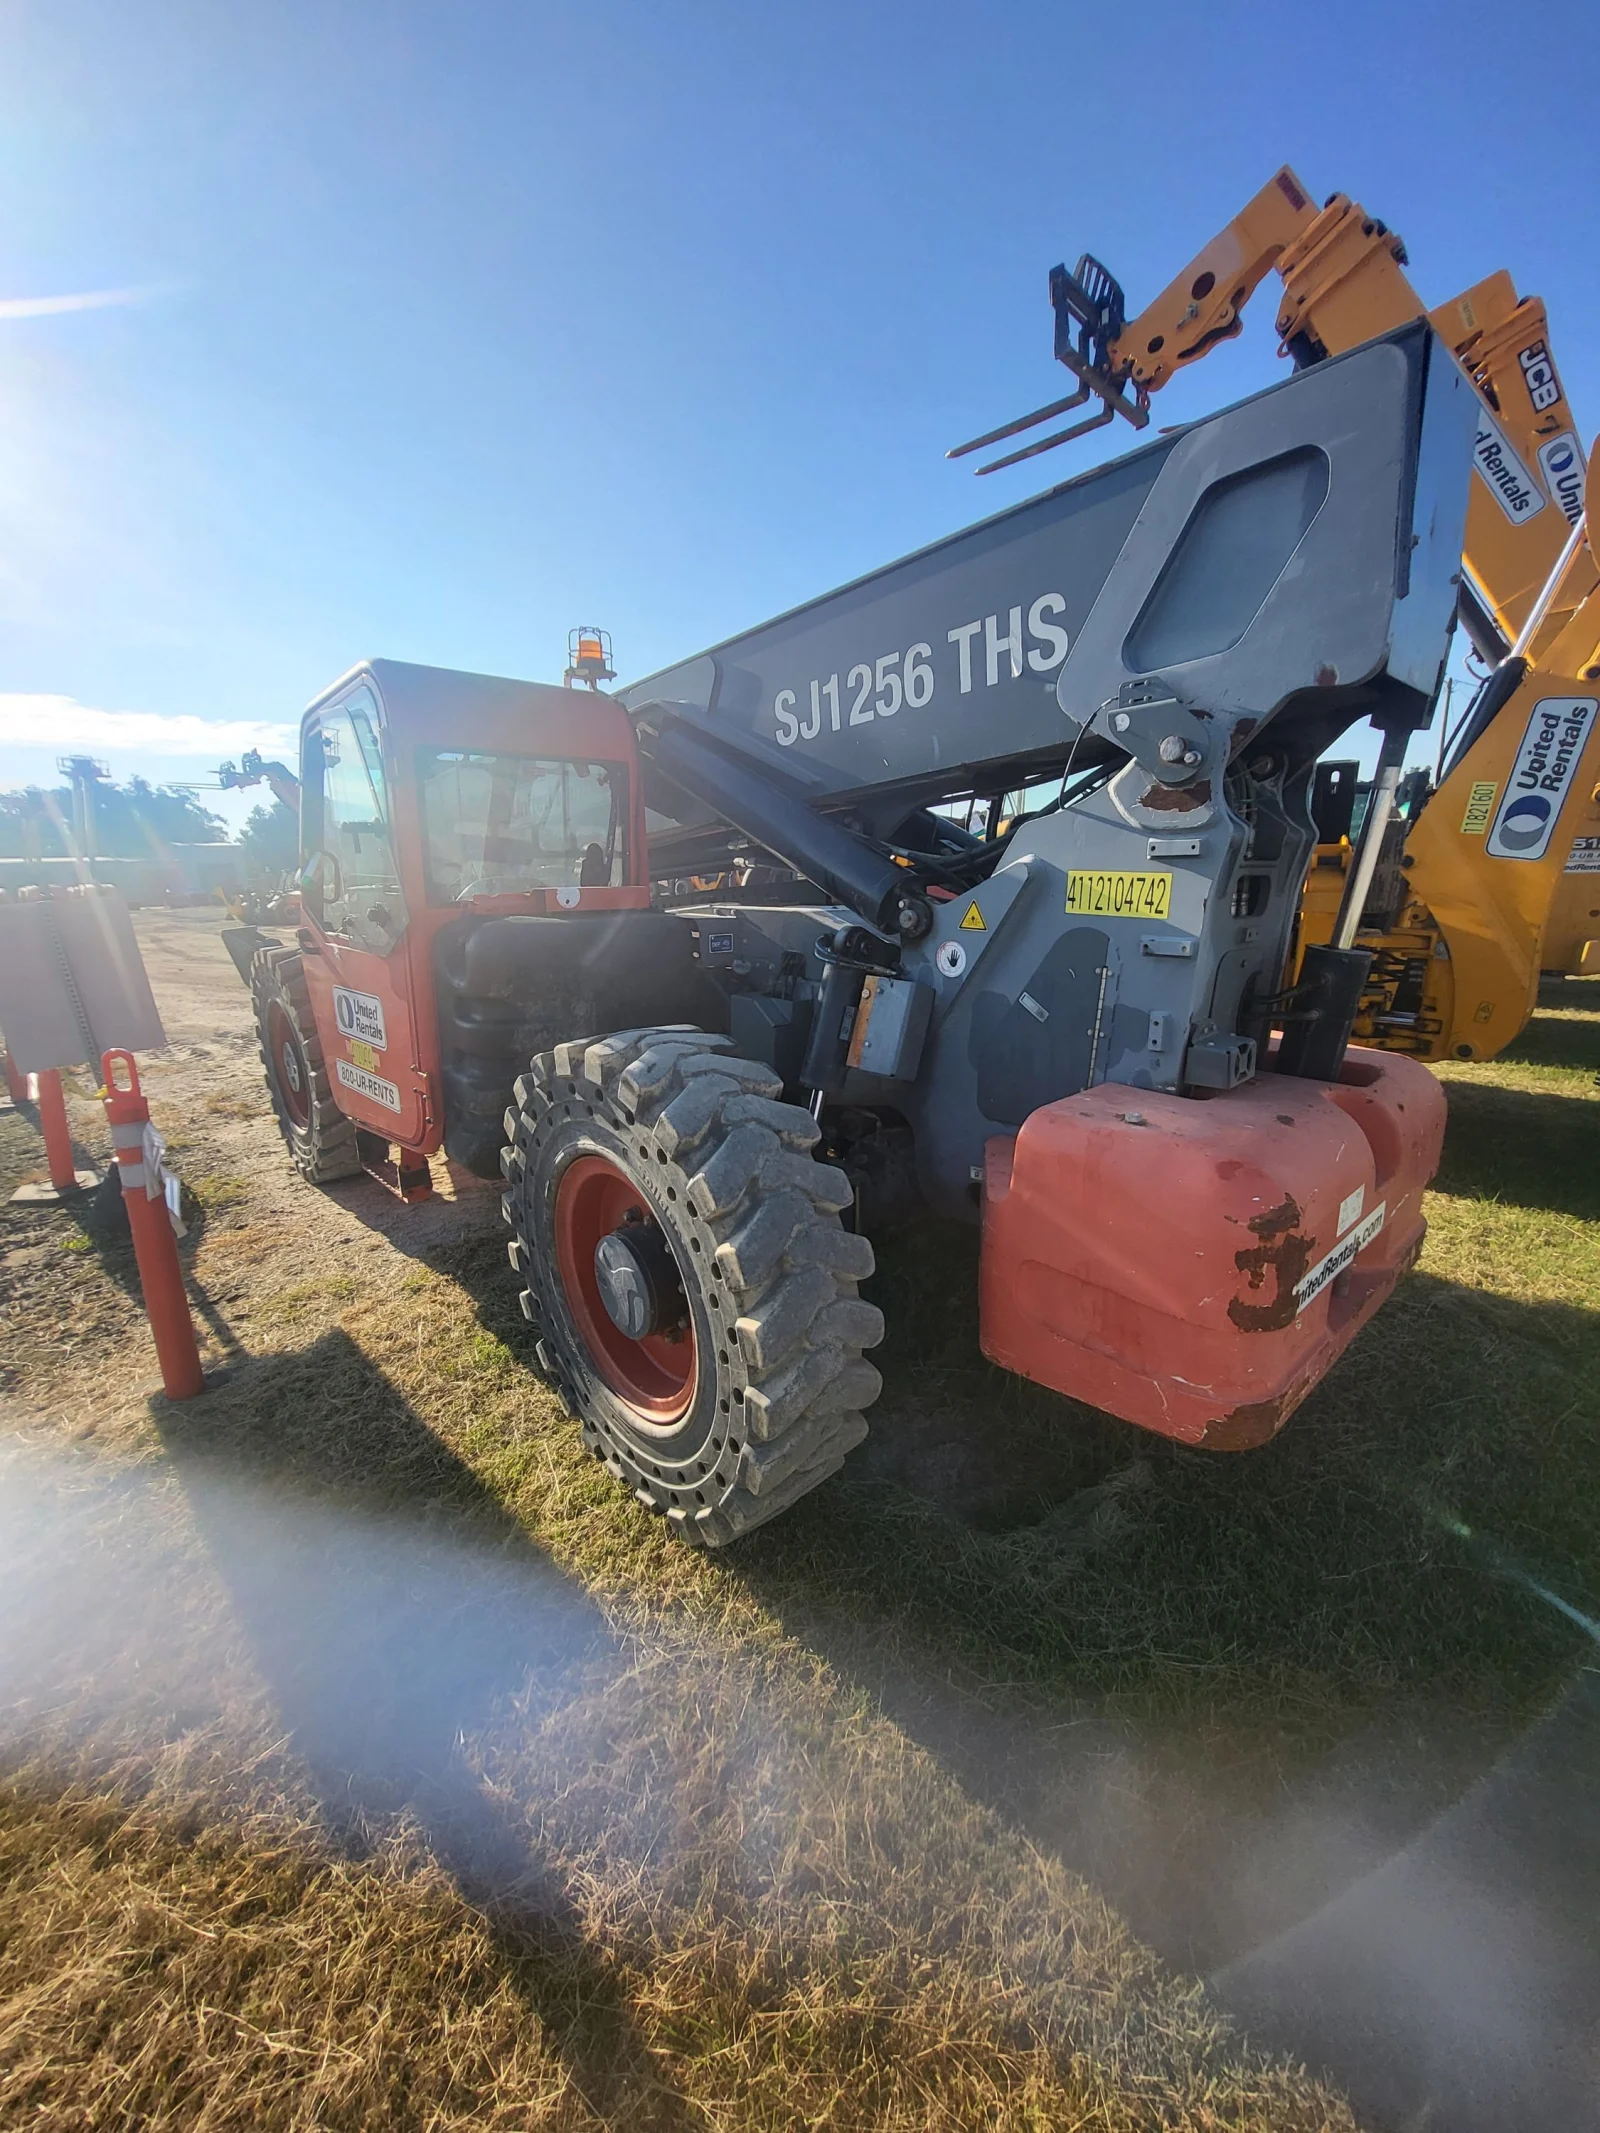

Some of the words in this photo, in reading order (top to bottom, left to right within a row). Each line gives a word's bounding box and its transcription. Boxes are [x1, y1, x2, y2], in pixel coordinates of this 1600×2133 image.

[1520, 349, 1559, 410] JCB
[1478, 441, 1531, 512] Rentals
[774, 642, 935, 747] SJ1256
[947, 592, 1069, 694] THS
[1516, 712, 1561, 790] United
[1540, 706, 1589, 792] Rentals
[1463, 783, 1496, 833] 11821601
[1067, 875, 1167, 915] 4112104742
[353, 999, 378, 1021] United
[355, 1016, 383, 1041] Rentals
[341, 1066, 395, 1105] 800-UR-RENTS
